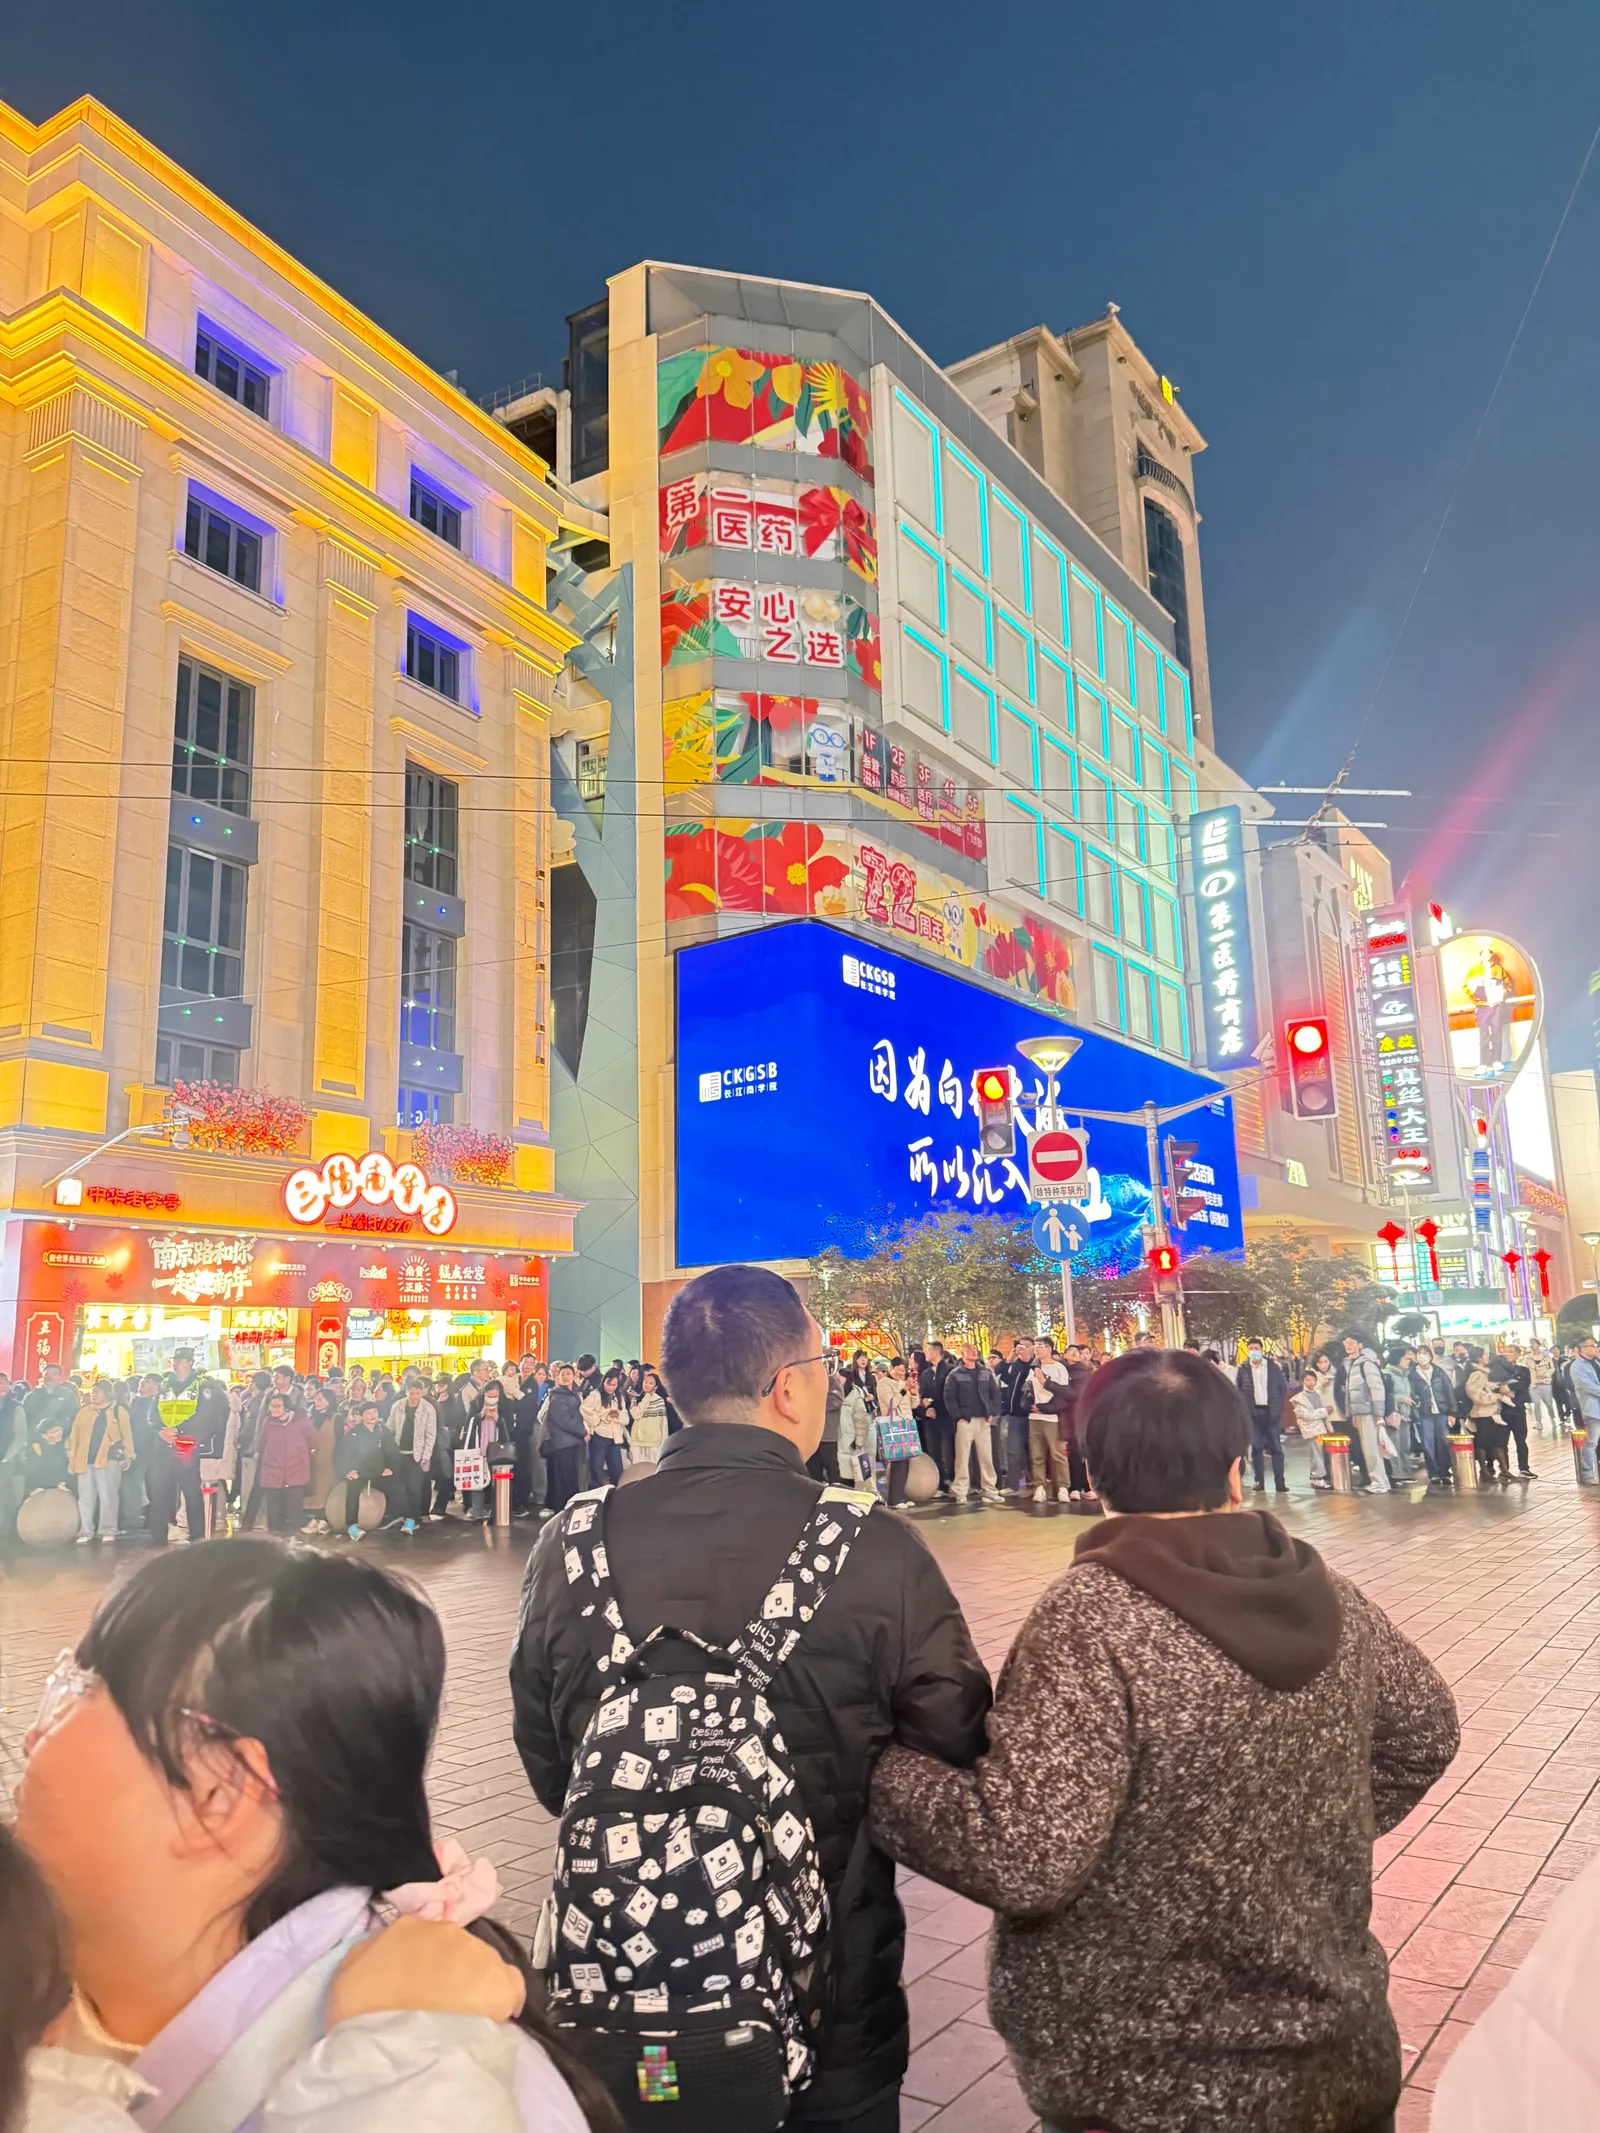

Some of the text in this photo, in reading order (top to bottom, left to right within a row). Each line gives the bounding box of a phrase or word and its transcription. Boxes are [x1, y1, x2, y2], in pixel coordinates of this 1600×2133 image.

[715, 511, 795, 552] 医药
[717, 586, 797, 625] 安心
[764, 628, 842, 665] 之选
[864, 730, 876, 751] 1F
[892, 746, 905, 767] 2F
[918, 764, 931, 783] 3F
[967, 795, 979, 812] 5F
[723, 1081, 778, 1099] 长江商学院
[1393, 1067, 1429, 1145] 真丝大王
[87, 1186, 181, 1211] 中华老字号
[152, 1238, 255, 1270] 南京路和你
[690, 1727, 724, 1737] Design
[688, 1739, 698, 1749] it
[699, 1766, 738, 1782] Chips
